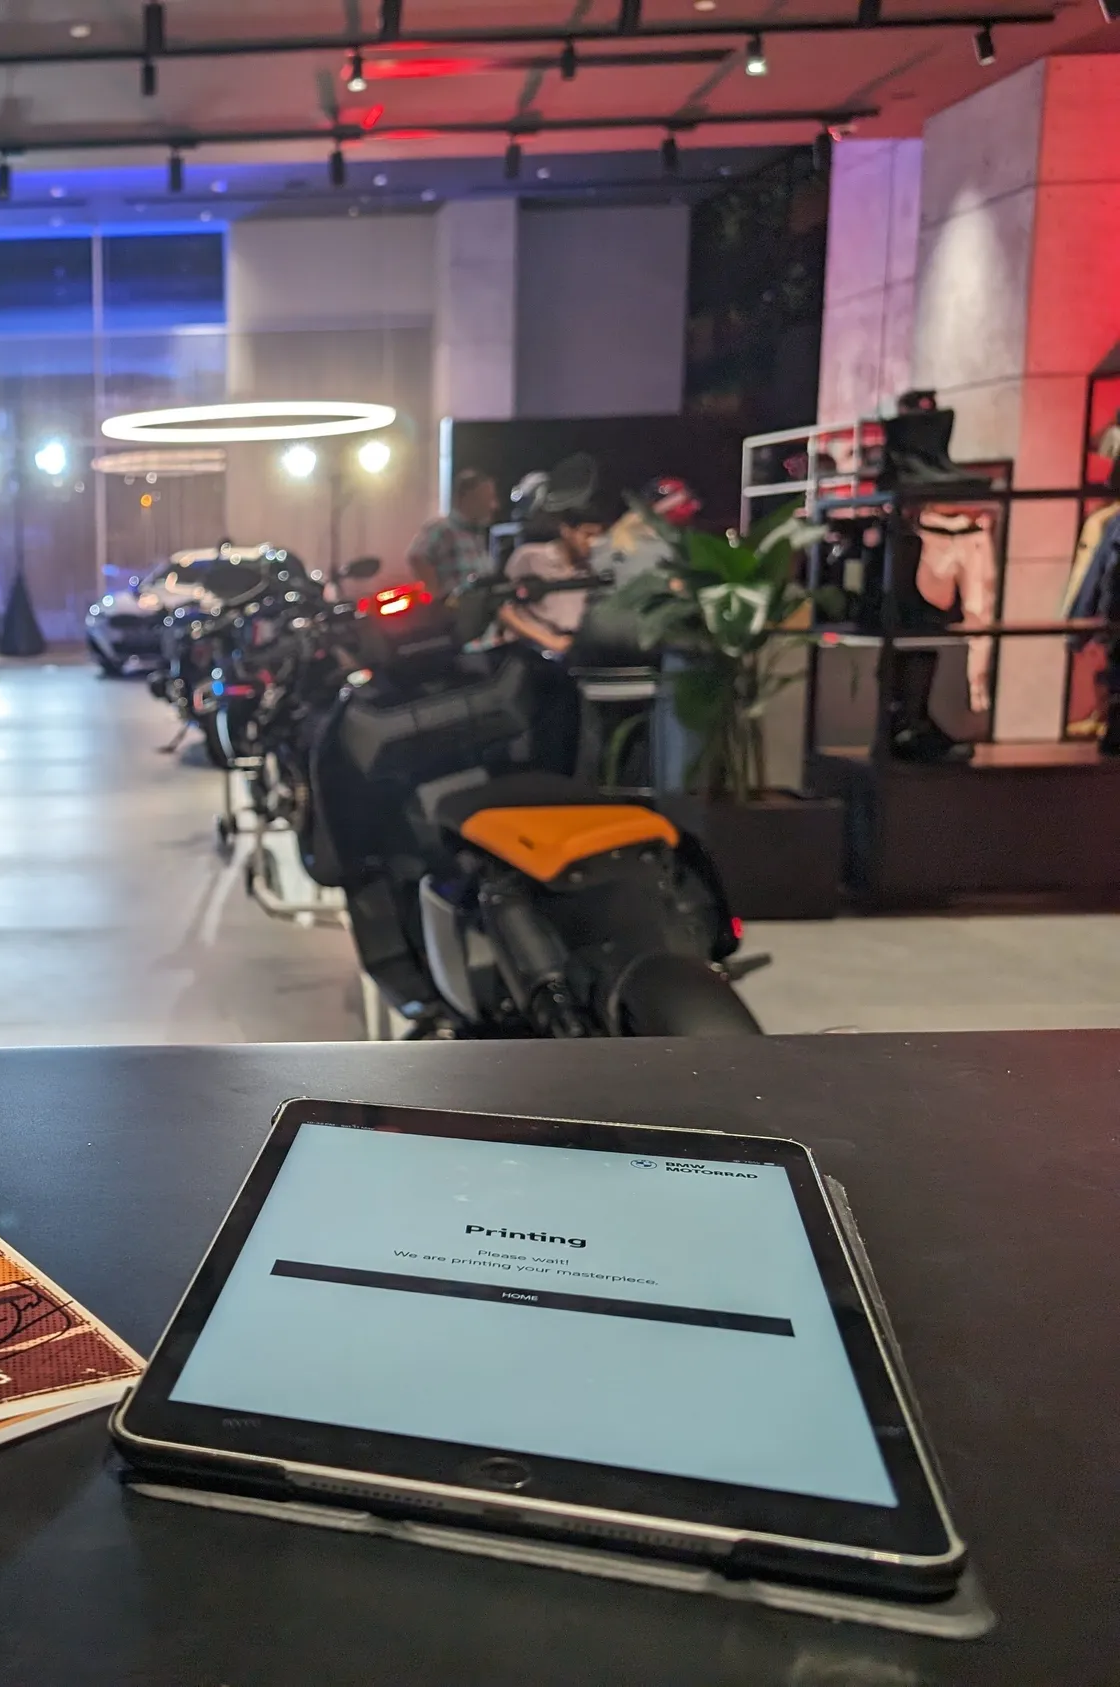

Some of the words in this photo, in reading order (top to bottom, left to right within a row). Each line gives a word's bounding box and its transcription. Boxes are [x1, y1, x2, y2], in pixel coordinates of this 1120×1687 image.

[665, 1161, 706, 1170] BMW
[665, 1166, 758, 1179] MOTORRAD
[465, 1224, 587, 1248] Printing
[478, 1249, 527, 1261] Please
[532, 1255, 569, 1266] wait!
[393, 1250, 418, 1259] We
[422, 1254, 446, 1262] are
[451, 1257, 511, 1271] printing
[516, 1264, 551, 1274] your
[556, 1268, 660, 1286] masterpiece.
[502, 1291, 539, 1302] HOME
